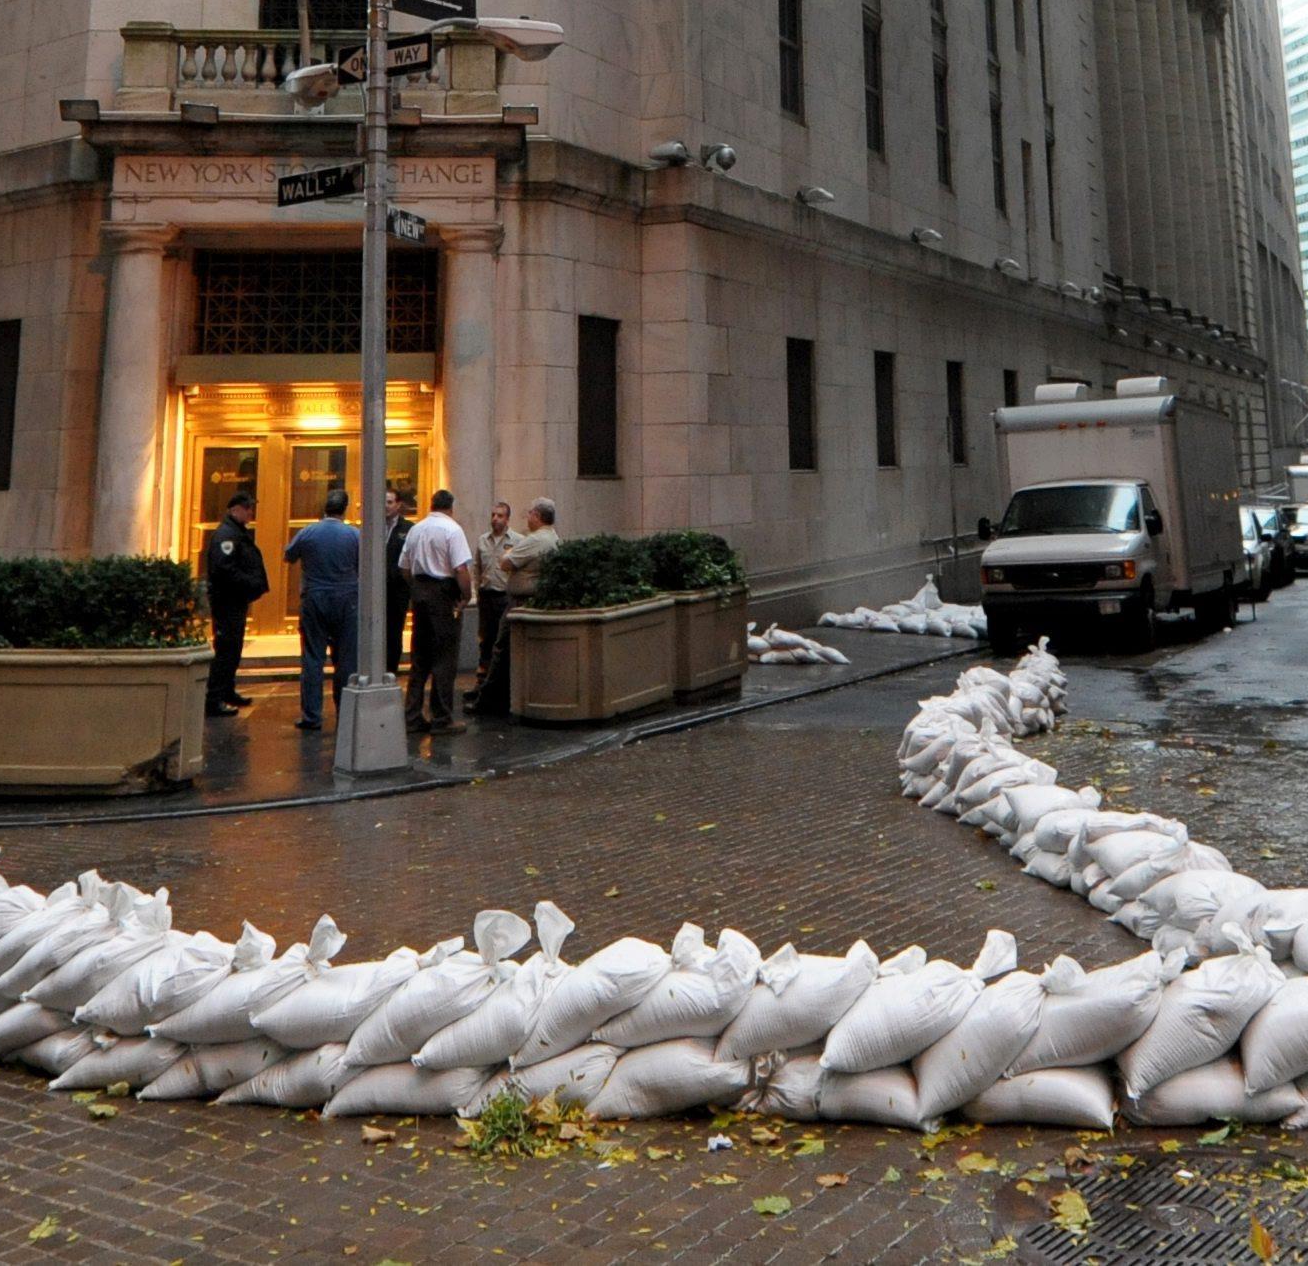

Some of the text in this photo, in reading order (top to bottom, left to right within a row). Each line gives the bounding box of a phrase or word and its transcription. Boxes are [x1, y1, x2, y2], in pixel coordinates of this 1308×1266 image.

[394, 46, 421, 65] WAY
[124, 163, 183, 183] NEW
[189, 163, 255, 184] YORK
[386, 163, 483, 184] CHANGE
[282, 175, 338, 201] WALL ST
[400, 218, 420, 240] NEW
